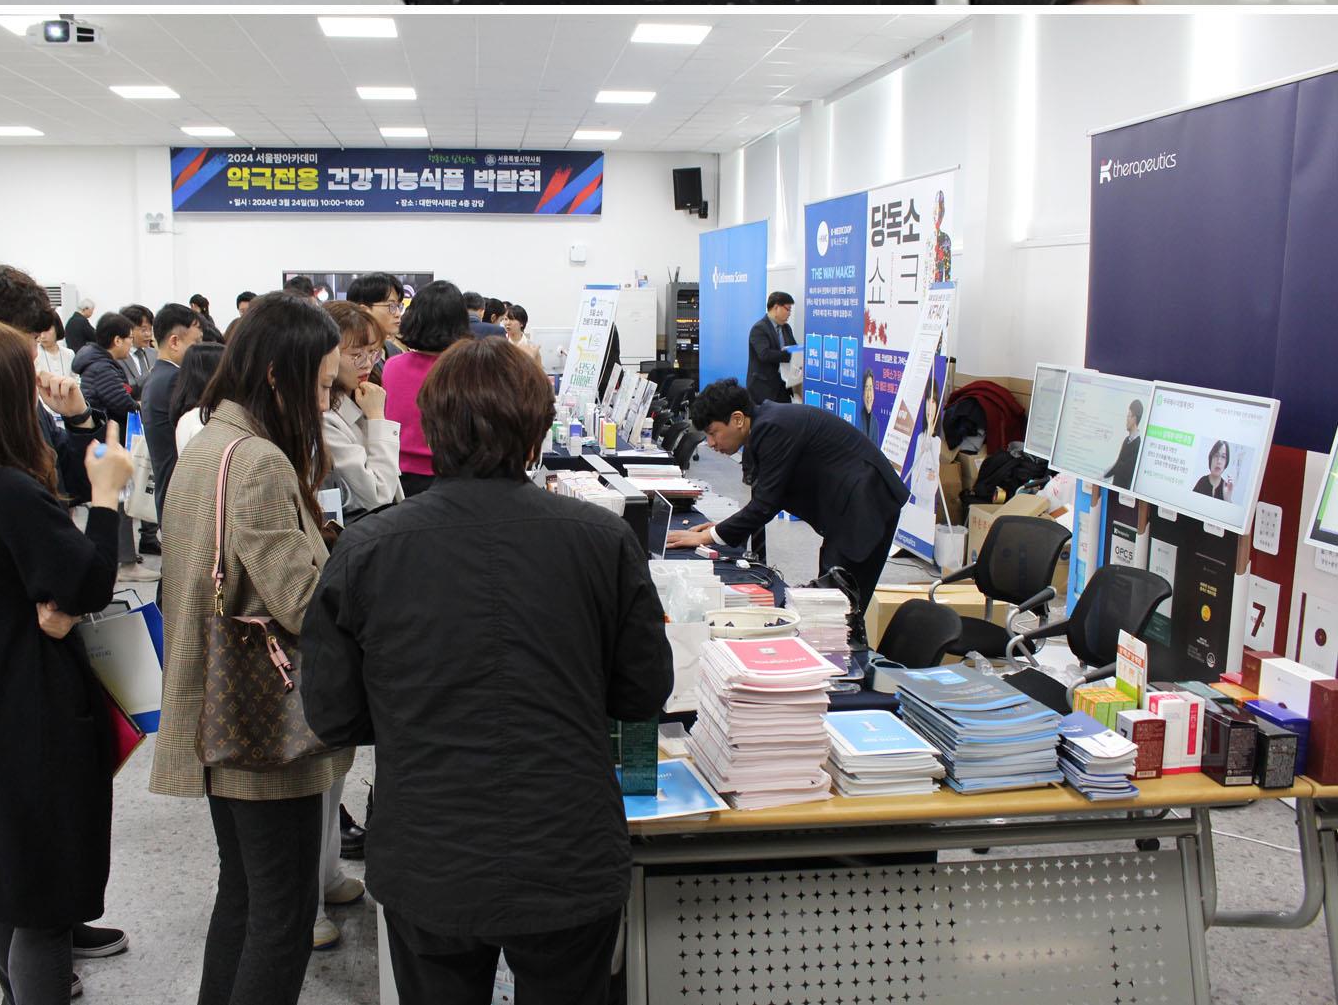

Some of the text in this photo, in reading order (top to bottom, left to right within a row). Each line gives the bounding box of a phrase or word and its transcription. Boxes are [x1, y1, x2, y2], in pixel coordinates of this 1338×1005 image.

[227, 153, 318, 164] 2024 서울팜아카데미
[1113, 152, 1176, 178] therapeutics
[227, 167, 541, 192] 약국전용 건강기능식품 박람회
[291, 199, 319, 207] 24일(일)
[419, 199, 457, 207] 대한약사회관
[459, 199, 470, 207] 4층
[871, 198, 921, 247] 당독소
[811, 265, 856, 280] THE WAY MAKER
